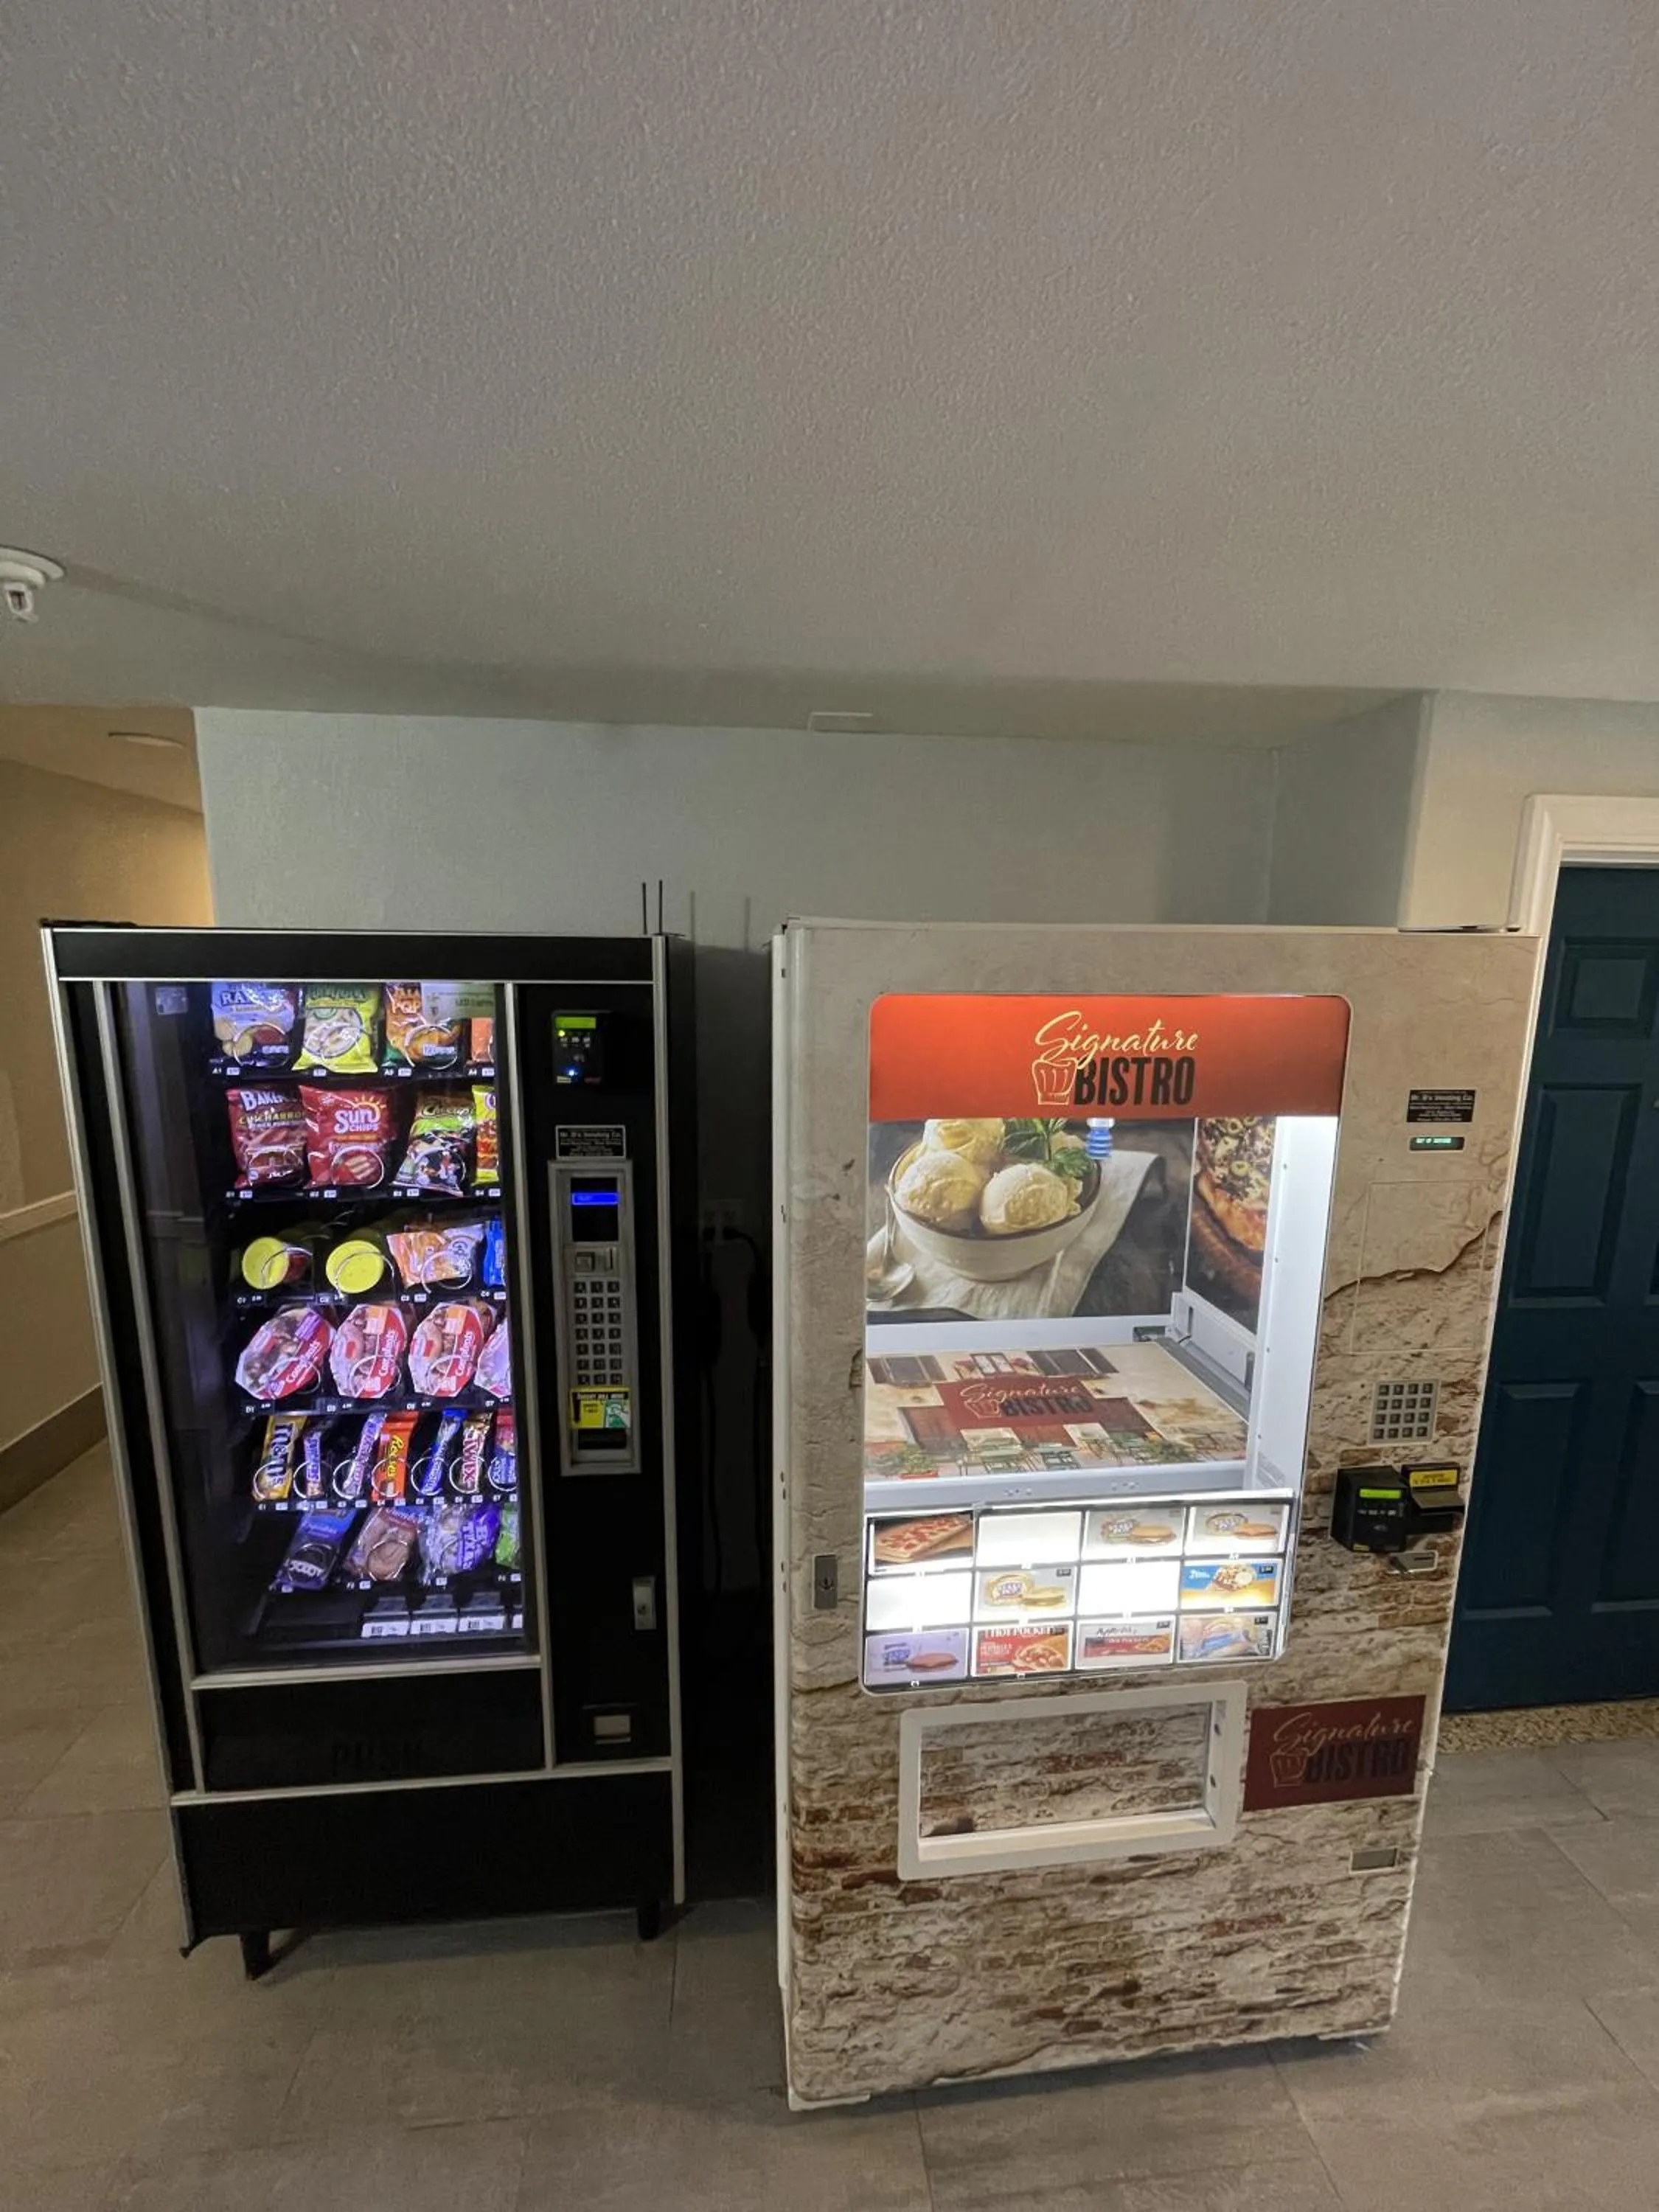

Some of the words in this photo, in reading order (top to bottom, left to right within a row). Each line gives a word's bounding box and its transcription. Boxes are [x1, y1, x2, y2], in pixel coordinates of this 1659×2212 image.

[1034, 1009, 1198, 1069] Signature
[1073, 1056, 1195, 1105] BISTRO
[960, 1382, 1082, 1403] Signature
[1001, 1395, 1094, 1417] BISTRO
[1273, 1712, 1413, 1758] Signature
[1304, 1738, 1411, 1784] BISTRO
